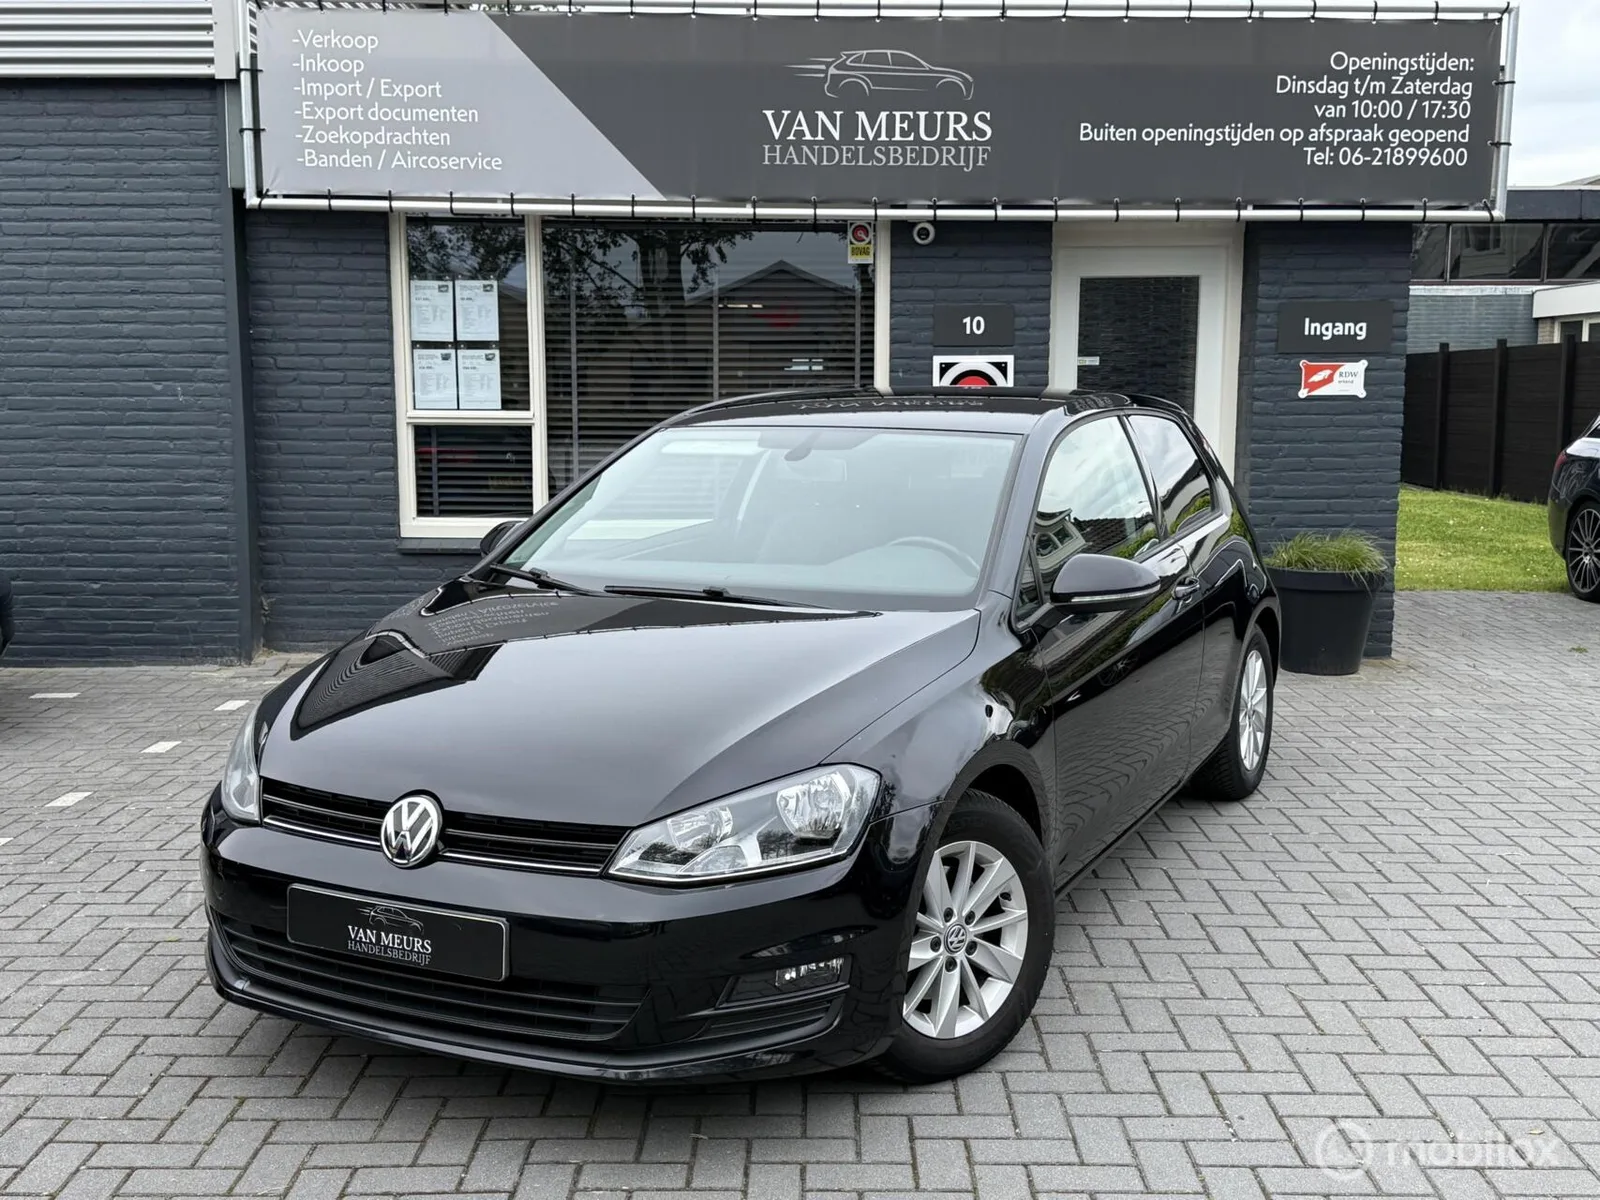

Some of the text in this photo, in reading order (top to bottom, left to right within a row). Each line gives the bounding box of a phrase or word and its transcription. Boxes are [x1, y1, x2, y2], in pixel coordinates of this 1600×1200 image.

[292, 29, 379, 54] -Verkoop
[292, 54, 364, 77] -Inkoop
[1330, 51, 1475, 75] Openingstijden:
[294, 78, 363, 101] -Import
[381, 79, 442, 102] Export
[1276, 76, 1473, 100] Dinsdag t/m Zaterdag
[295, 103, 479, 125] -Export documenten
[1314, 104, 1347, 119] van
[1351, 100, 1404, 119] 10:00
[1421, 100, 1472, 119] 17:30
[296, 125, 450, 148] -Zoekopdrachten
[762, 110, 993, 141] VAN MEURS
[1079, 123, 1470, 147] Buiten openingstijden op afspraak geopend
[297, 149, 373, 169] -Banden
[391, 151, 503, 171] Aircoservice
[762, 145, 992, 172] HANDELSBEDRIJF
[1303, 147, 1468, 167] Tel: 06-21899600
[851, 247, 870, 256] BOVAG
[962, 316, 985, 335] 10
[1304, 317, 1367, 341] Ingang
[1338, 371, 1358, 379] RDW
[348, 925, 432, 954] VAN MEURS
[348, 940, 432, 966] HANDELSBEDRIJF
